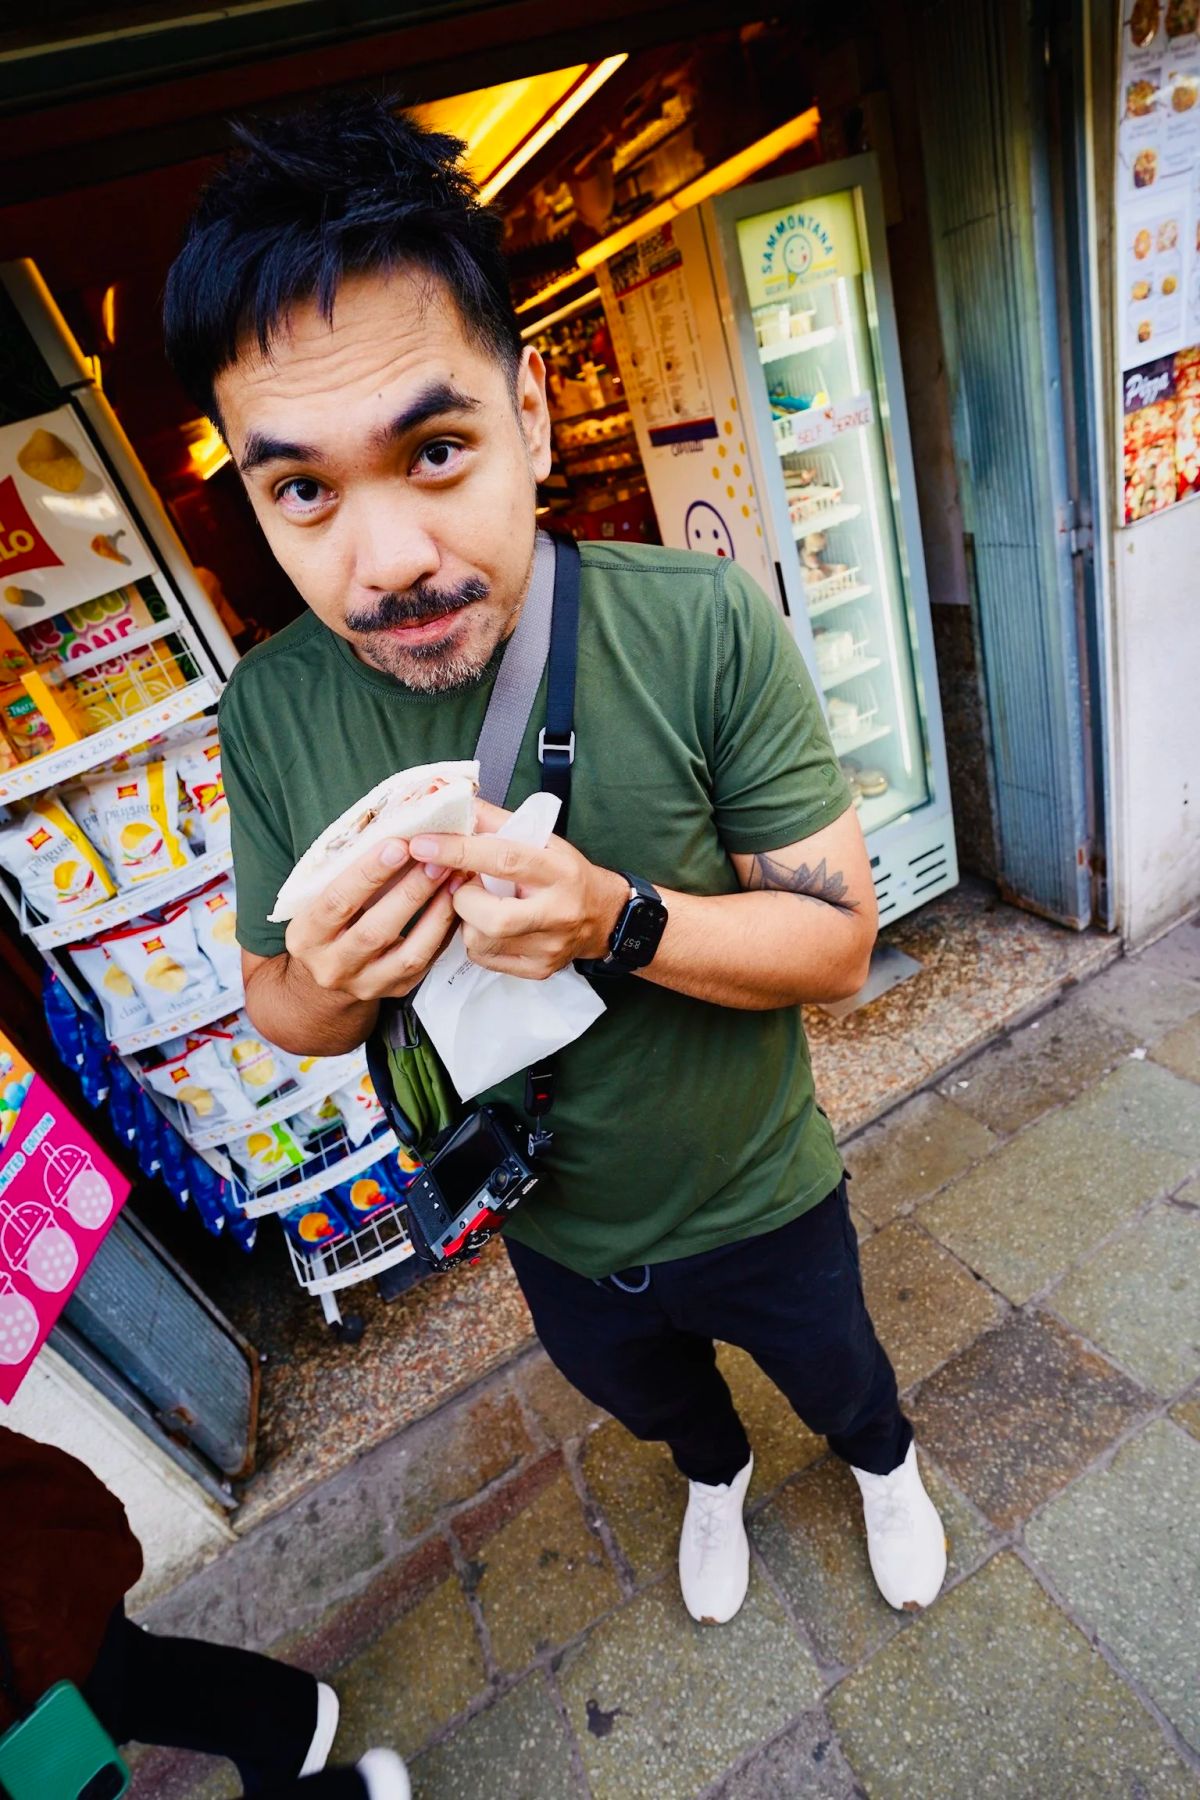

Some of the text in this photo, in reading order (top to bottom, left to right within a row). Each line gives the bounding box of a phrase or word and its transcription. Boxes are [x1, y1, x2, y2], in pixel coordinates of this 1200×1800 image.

[762, 214, 834, 274] SAMMONTANA
[1125, 372, 1170, 407] Pizza
[798, 423, 823, 445] SELF
[832, 407, 870, 434] SERVICE
[0, 529, 35, 562] LO
[623, 937, 641, 950] 8:57
[22, 1115, 53, 1154] EDITION
